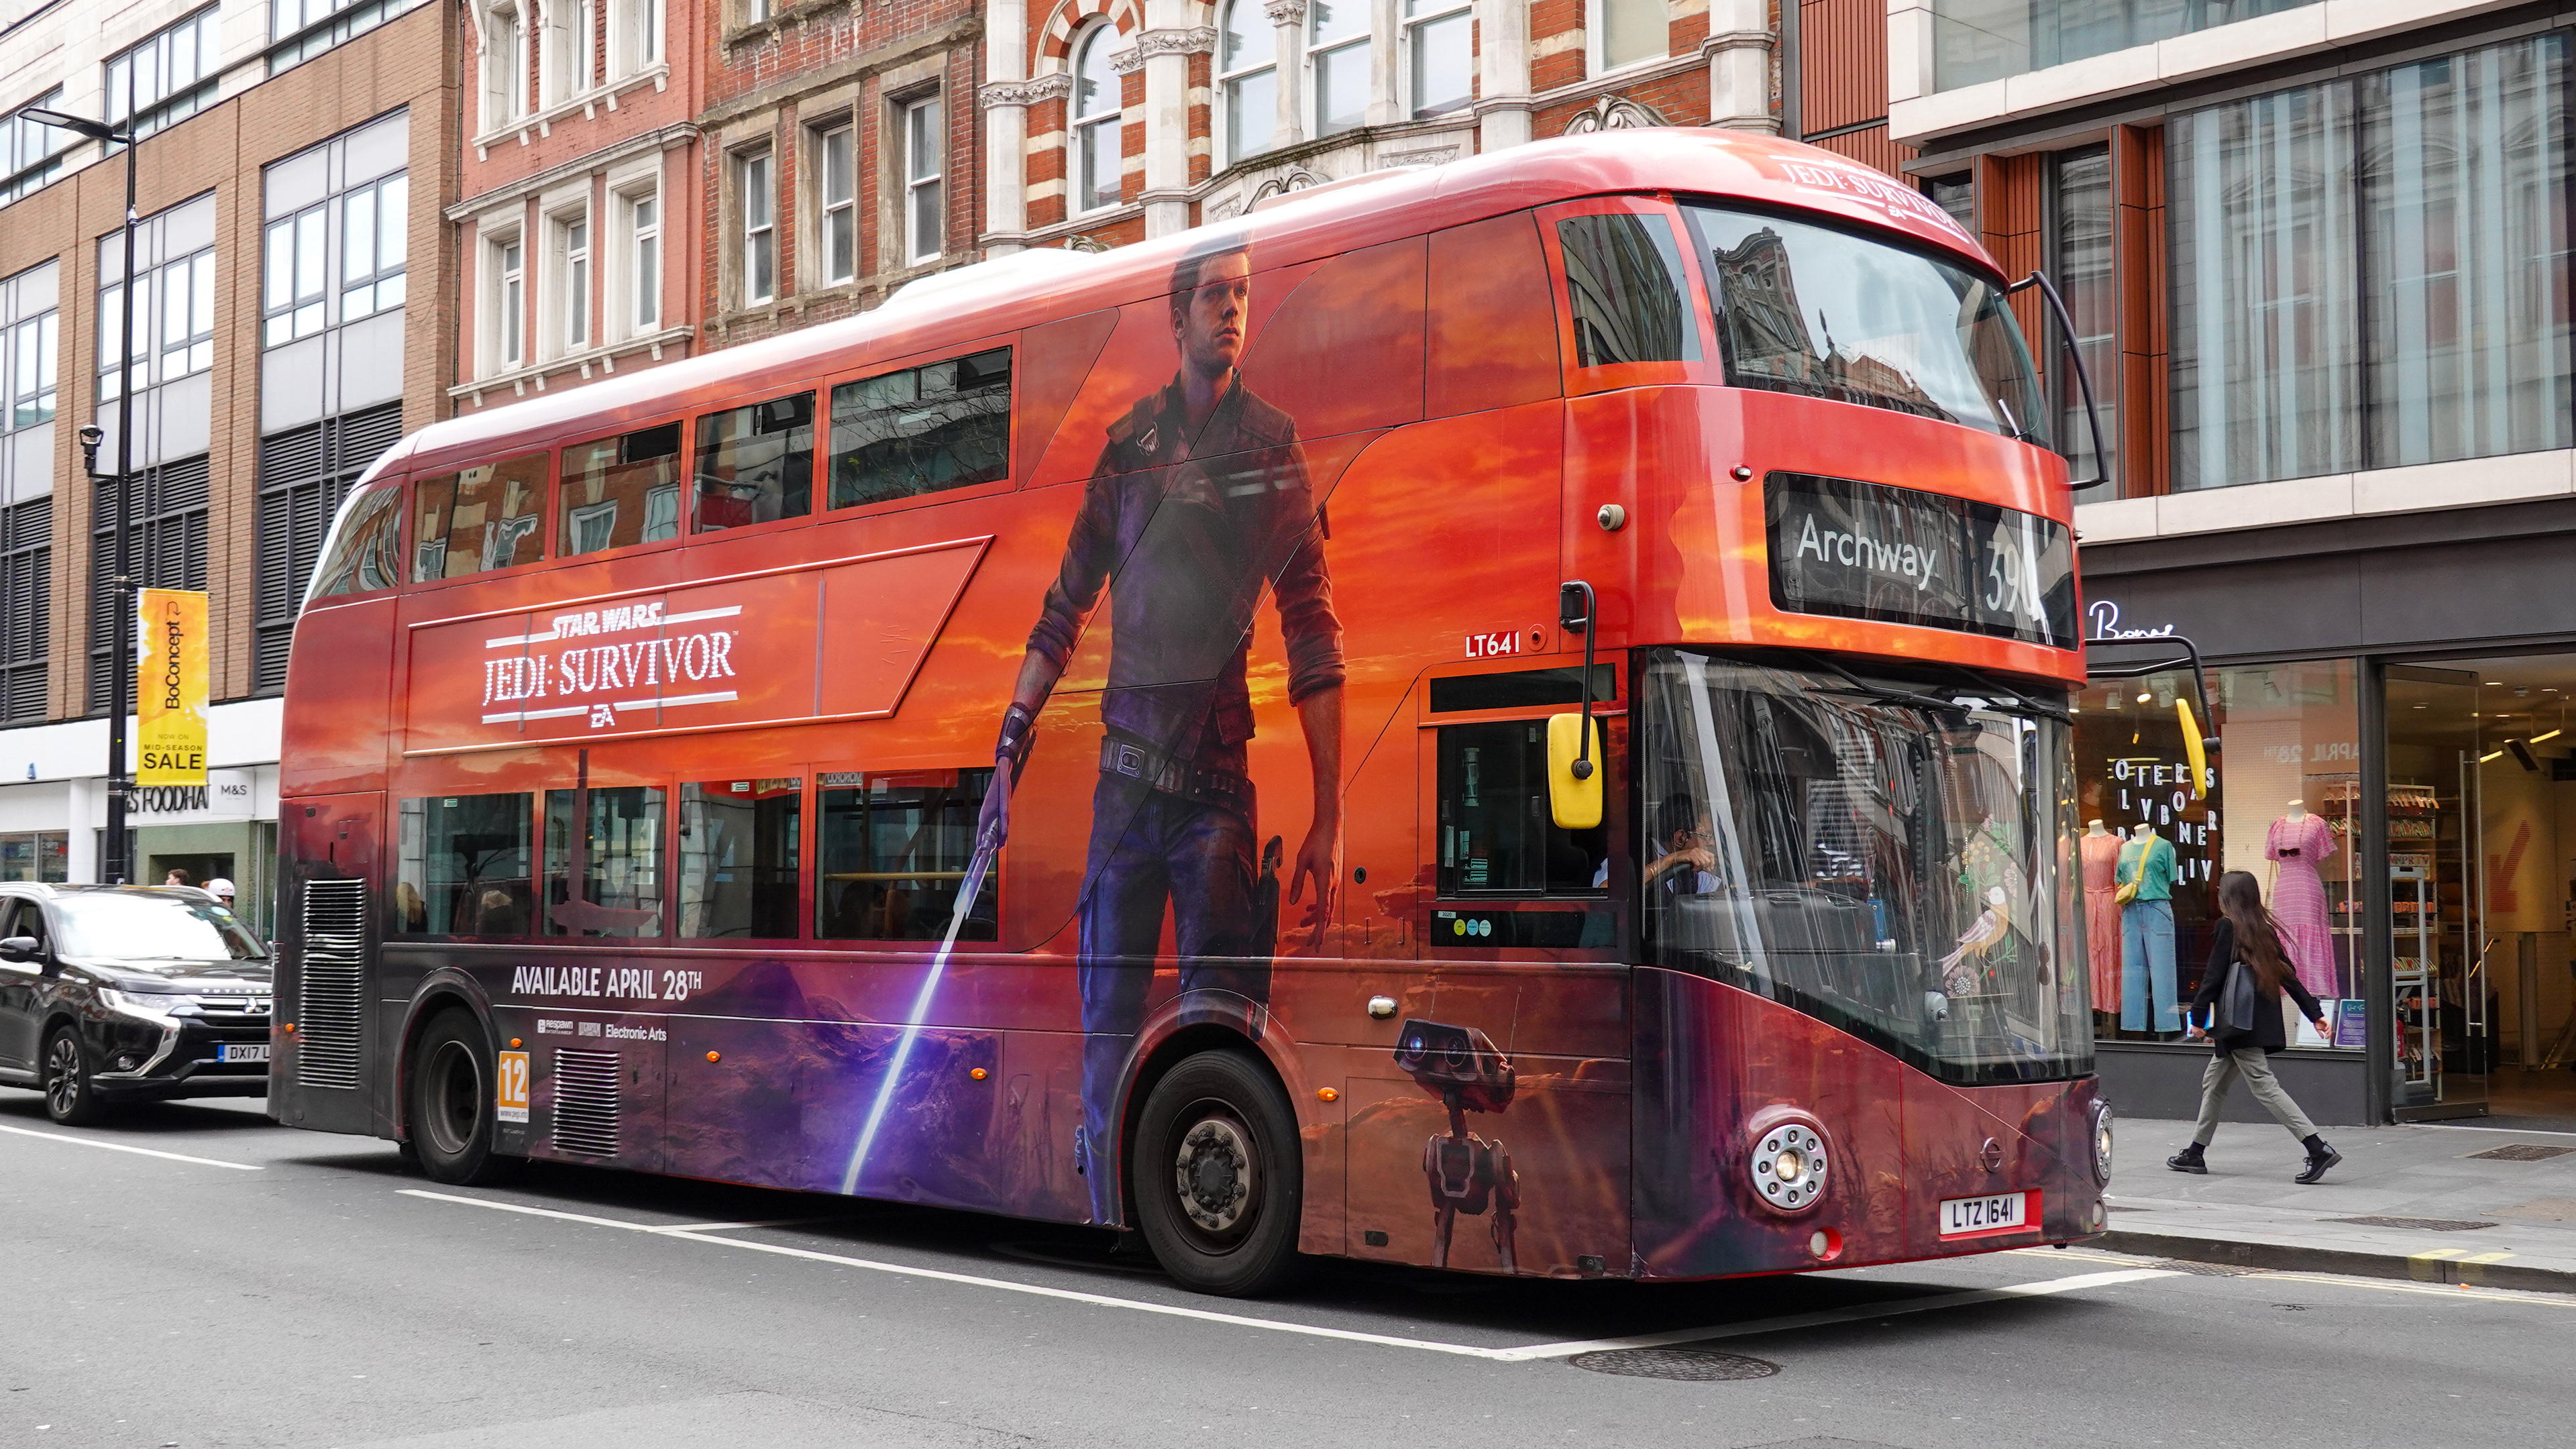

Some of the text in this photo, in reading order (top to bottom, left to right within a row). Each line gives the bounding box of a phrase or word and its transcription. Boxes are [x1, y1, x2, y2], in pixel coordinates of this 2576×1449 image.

[1847, 174, 1963, 233] SURVIVOR
[1888, 205, 1907, 219] EA
[1796, 513, 1937, 590] Archway
[552, 602, 663, 639] STAR WARS
[1466, 631, 1520, 658] LT641
[165, 621, 184, 709] BoConcept
[559, 631, 736, 696] SURVIVOR
[590, 703, 616, 728] EA
[144, 753, 202, 769] SALE
[221, 784, 248, 796] M&S
[511, 966, 702, 1001] AVAILABLE APRIL 28TH
[606, 1024, 648, 1040] Electronic
[648, 1026, 667, 1041] Arts
[230, 1046, 259, 1059] DX17
[502, 1058, 527, 1102] 12
[1953, 1197, 2012, 1228] LTZ 1641
